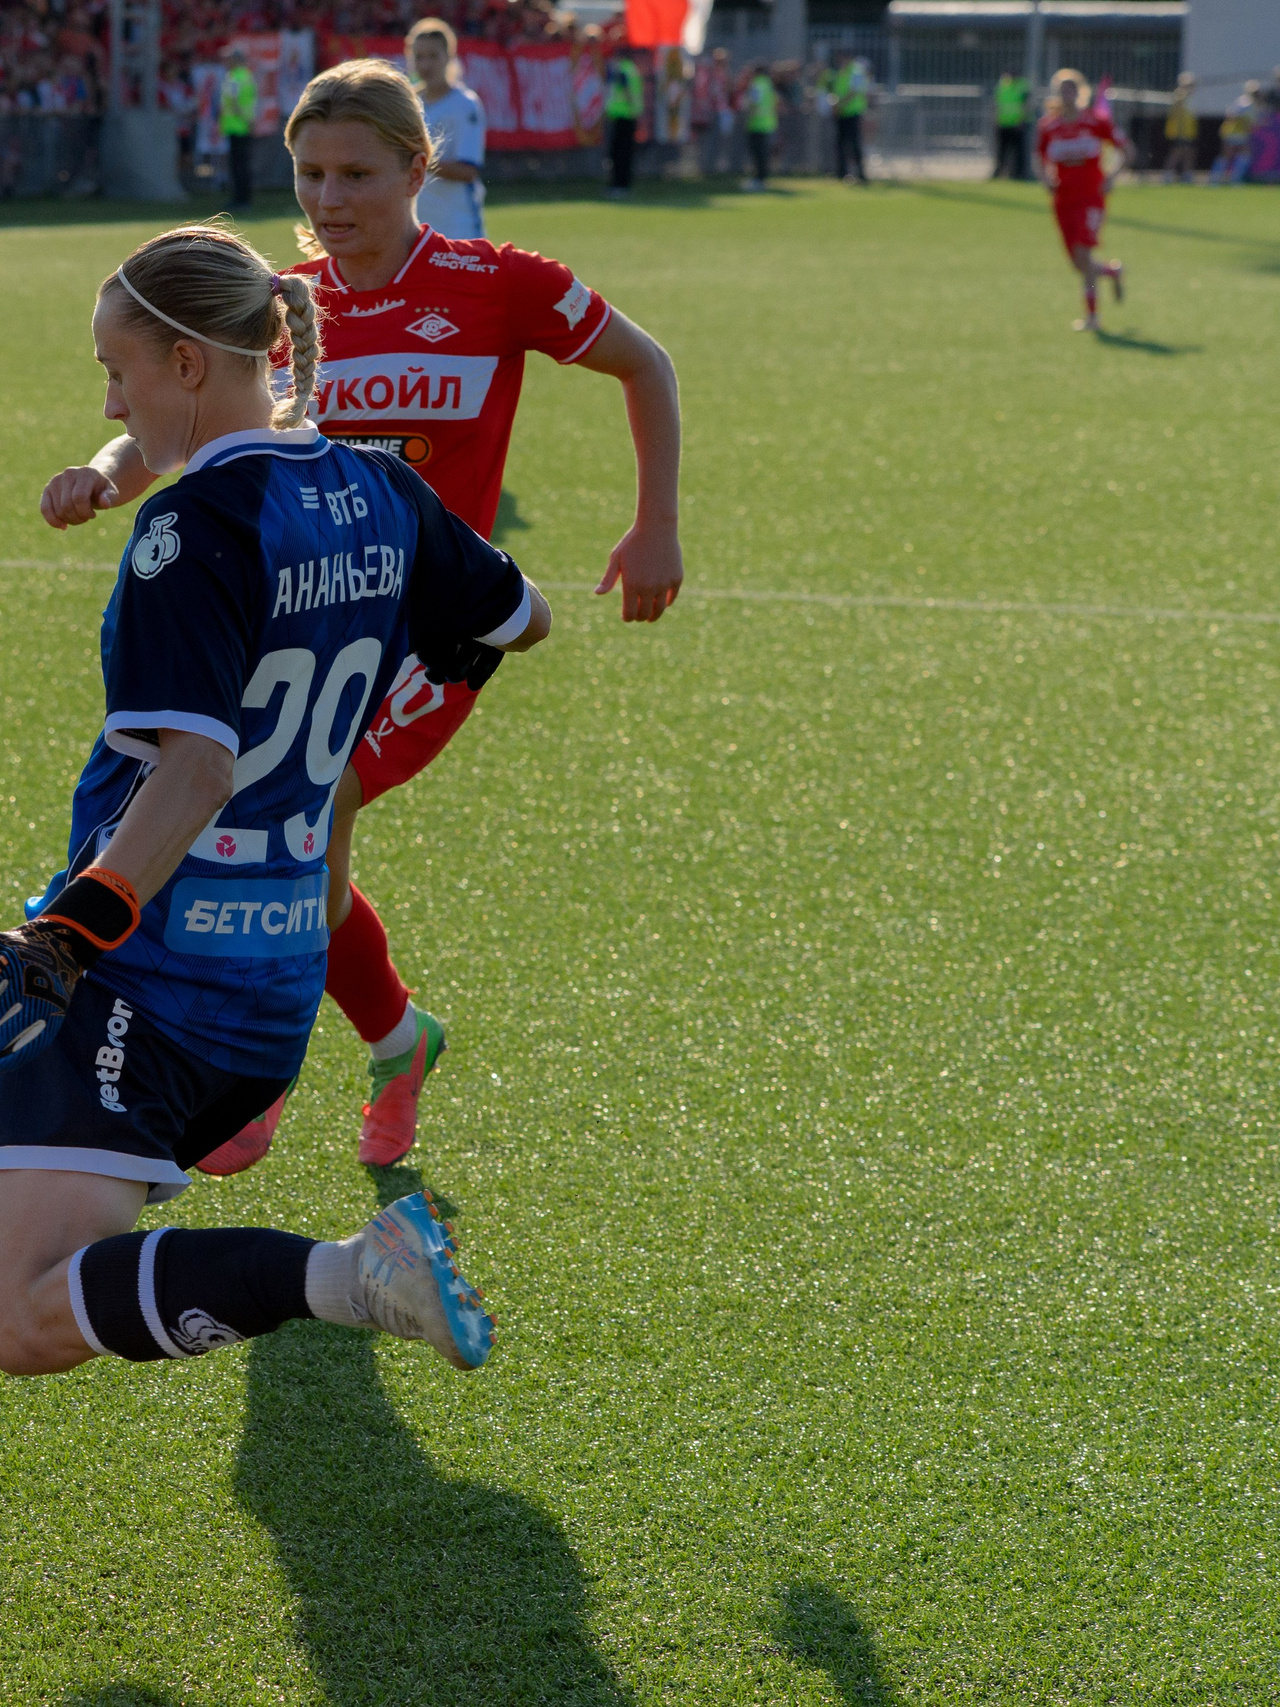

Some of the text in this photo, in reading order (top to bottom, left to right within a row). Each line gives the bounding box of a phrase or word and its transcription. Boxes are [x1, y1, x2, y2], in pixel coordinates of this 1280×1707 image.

[287, 366, 462, 416] УКОЙЛ
[325, 482, 369, 526] ВТБ
[272, 545, 405, 618] АНАНЬЕВА
[188, 637, 382, 866] 29
[184, 895, 327, 935] БЕТСИТИ
